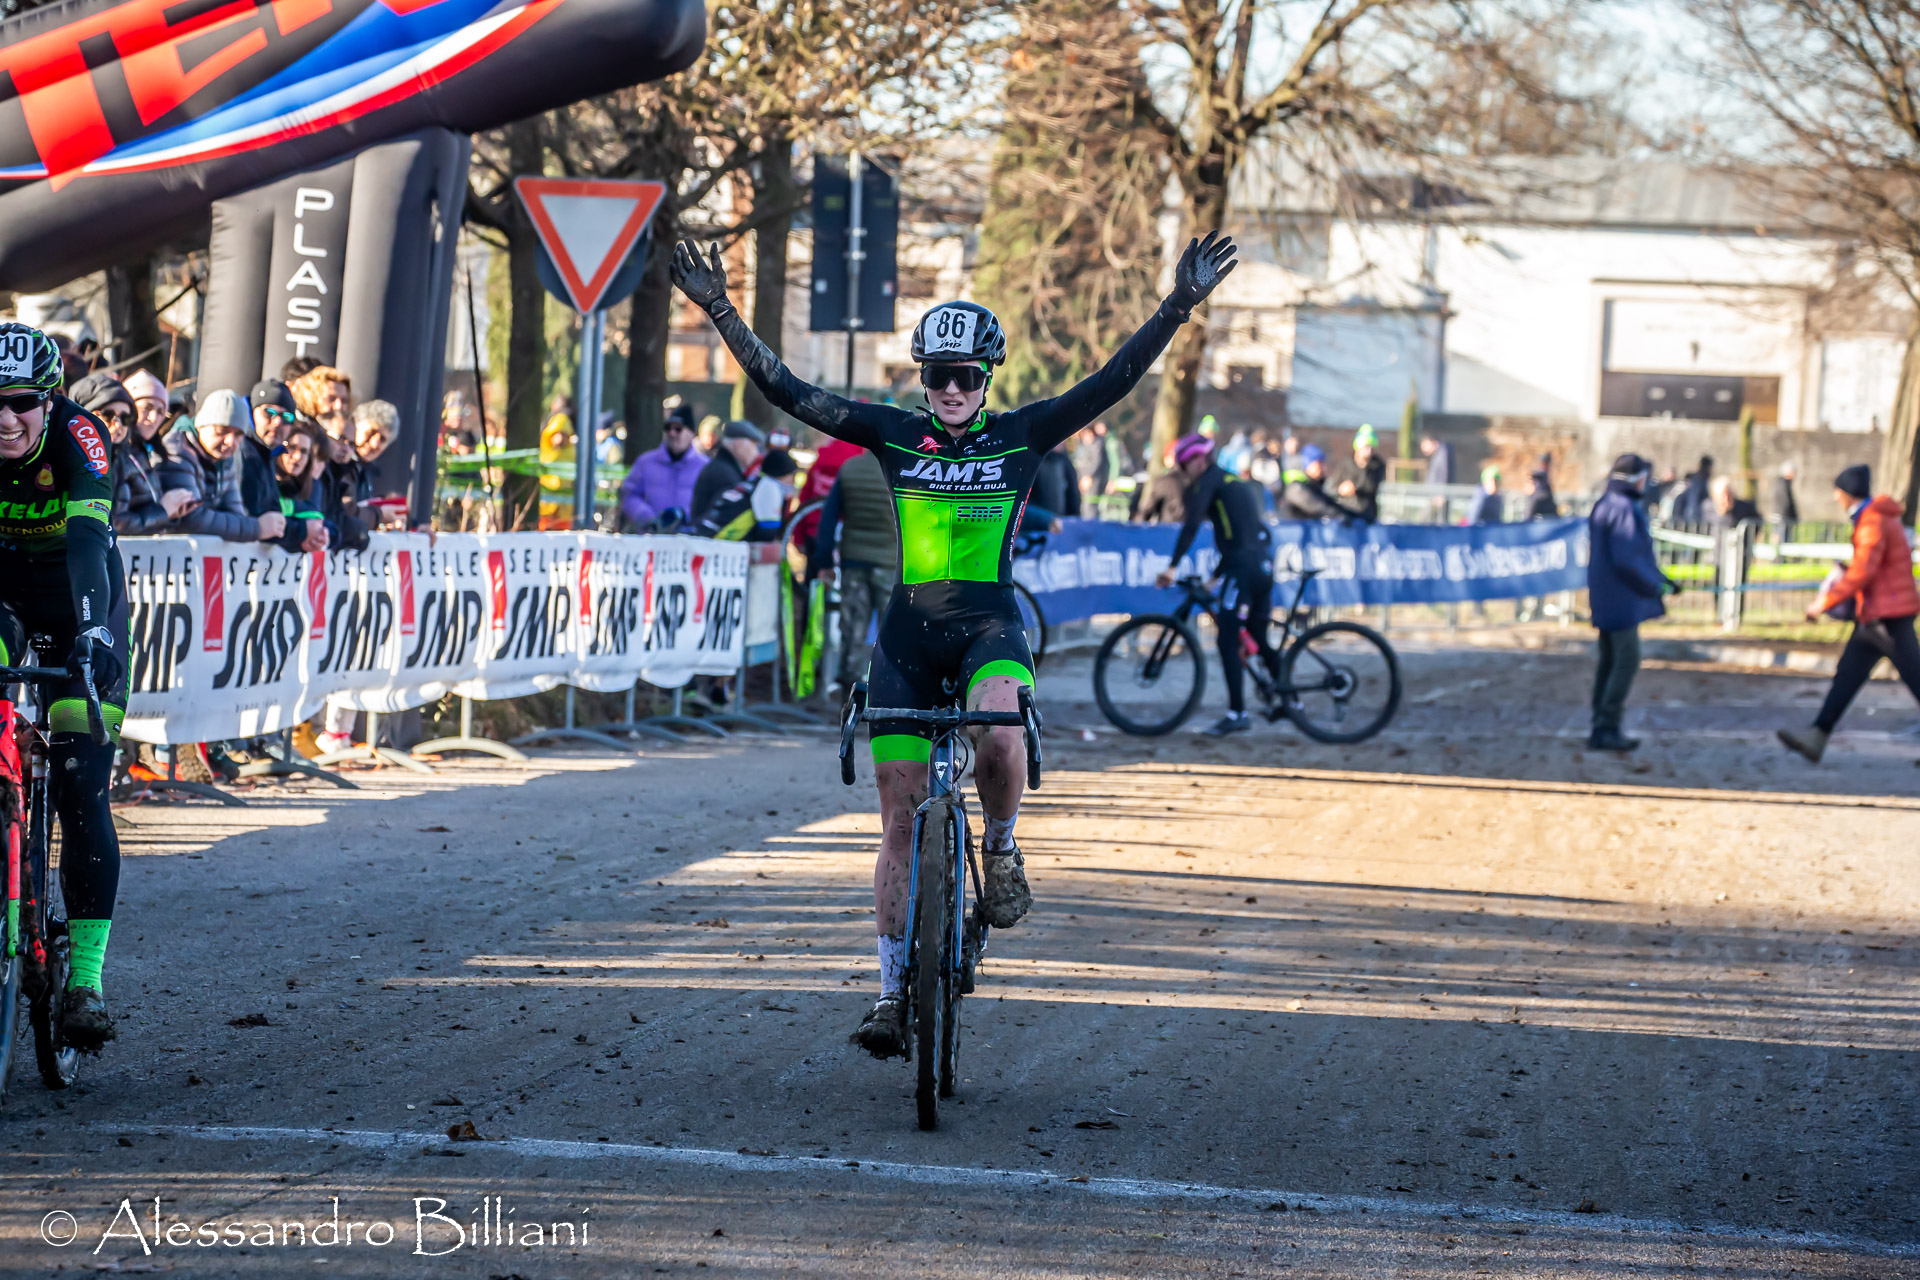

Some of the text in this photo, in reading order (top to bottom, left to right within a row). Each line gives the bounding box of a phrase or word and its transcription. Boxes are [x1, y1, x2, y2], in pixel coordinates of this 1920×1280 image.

[285, 187, 334, 358] PLAST
[936, 310, 967, 339] 86
[76, 426, 108, 471] CASA
[900, 458, 1005, 483] JAM'S
[928, 482, 1007, 491] BIKE TEAM BUJA
[130, 555, 192, 586] ELLE
[230, 556, 302, 586] SELLE
[416, 551, 478, 577] SELLE
[510, 549, 574, 573] SELLE
[317, 590, 393, 674] SMP
[405, 590, 483, 668] SMP
[494, 587, 571, 660] SMP
[212, 598, 304, 690] SMP
